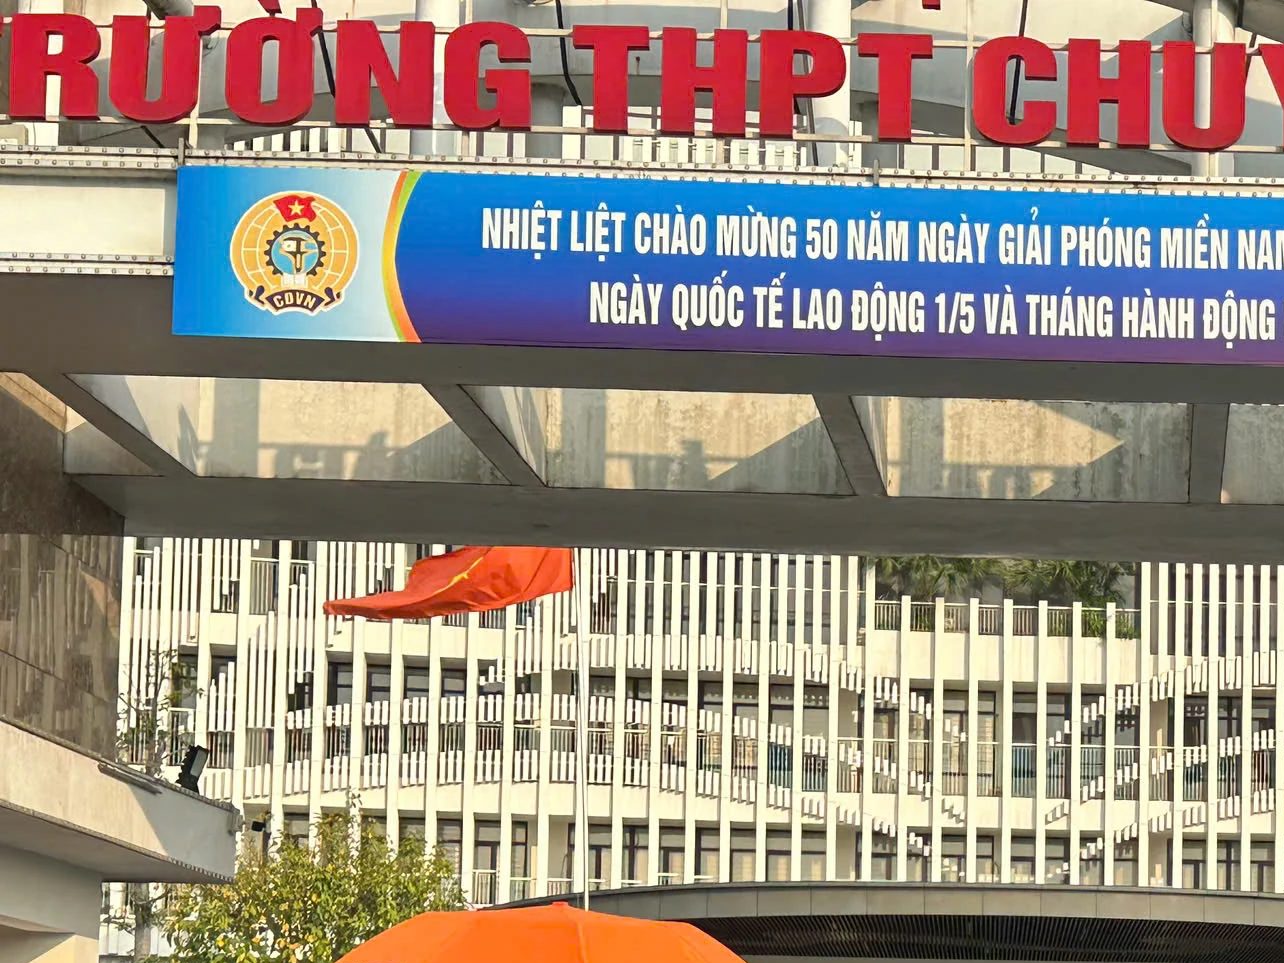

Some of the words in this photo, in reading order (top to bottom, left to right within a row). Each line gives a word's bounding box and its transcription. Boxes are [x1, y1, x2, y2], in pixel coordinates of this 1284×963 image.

[0, 0, 533, 130] RƯỜNG
[570, 24, 936, 144] THPT
[482, 200, 562, 260] NHIỆT
[570, 202, 626, 262] LIỆT
[634, 205, 707, 256] CHÀO
[716, 205, 797, 258] MỪNG
[805, 218, 838, 260] 50
[847, 211, 909, 262] NĂM
[918, 214, 990, 264] NGÀY
[998, 206, 1051, 266] GIẢI
[1061, 218, 1151, 269] PHÓNG
[1160, 213, 1229, 270] MIỀN
[590, 274, 663, 325] NGÀY
[672, 270, 744, 331] QUỐC
[752, 272, 786, 329] TẾ
[792, 287, 843, 331] LAO
[850, 281, 925, 342] ĐỘNG
[934, 291, 975, 334] 1/5
[983, 284, 1018, 335] VÀ
[1025, 286, 1113, 338] THÁNG
[1122, 288, 1195, 339] HÀNH
[1202, 289, 1276, 349] ĐỘNG
